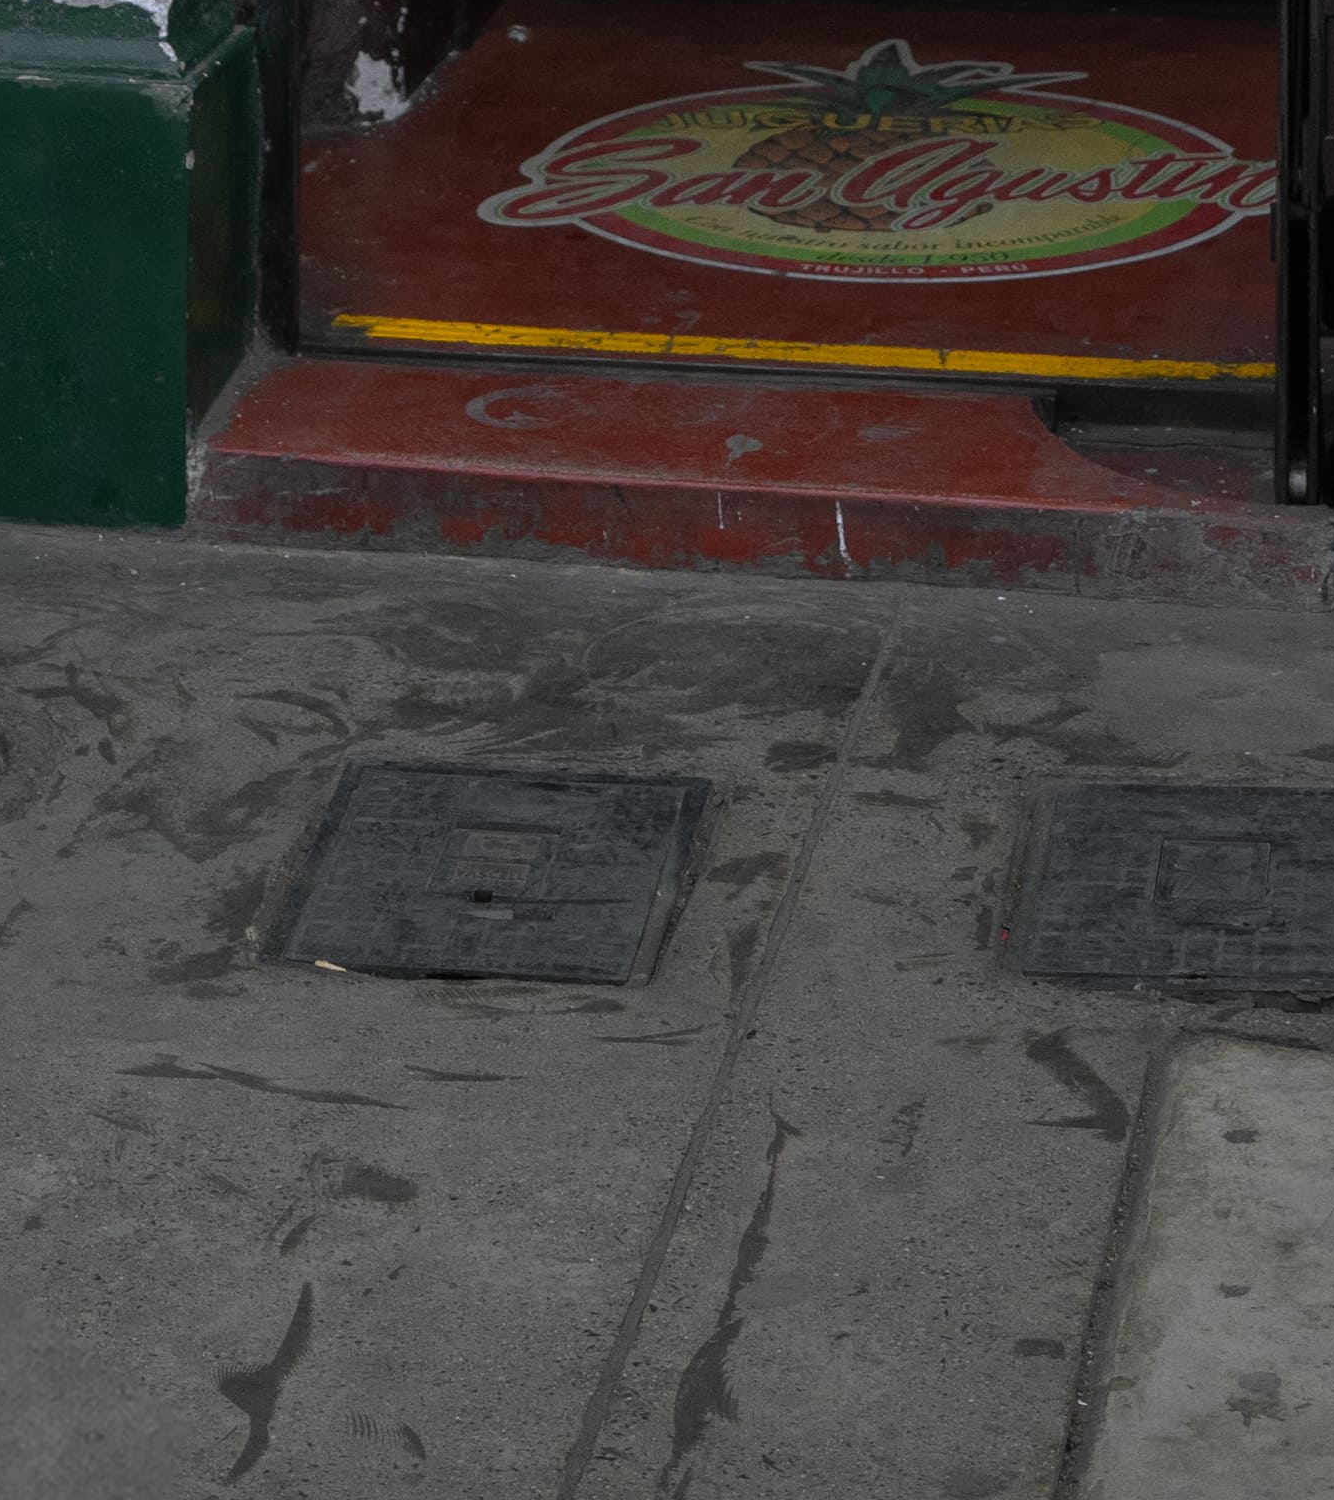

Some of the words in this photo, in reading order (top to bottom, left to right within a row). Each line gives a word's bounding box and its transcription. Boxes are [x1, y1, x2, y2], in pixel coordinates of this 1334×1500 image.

[655, 107, 1104, 135] JUGUERIAS
[495, 138, 817, 220] San
[860, 238, 944, 252] sabor
[800, 263, 925, 276] TRUJILLO
